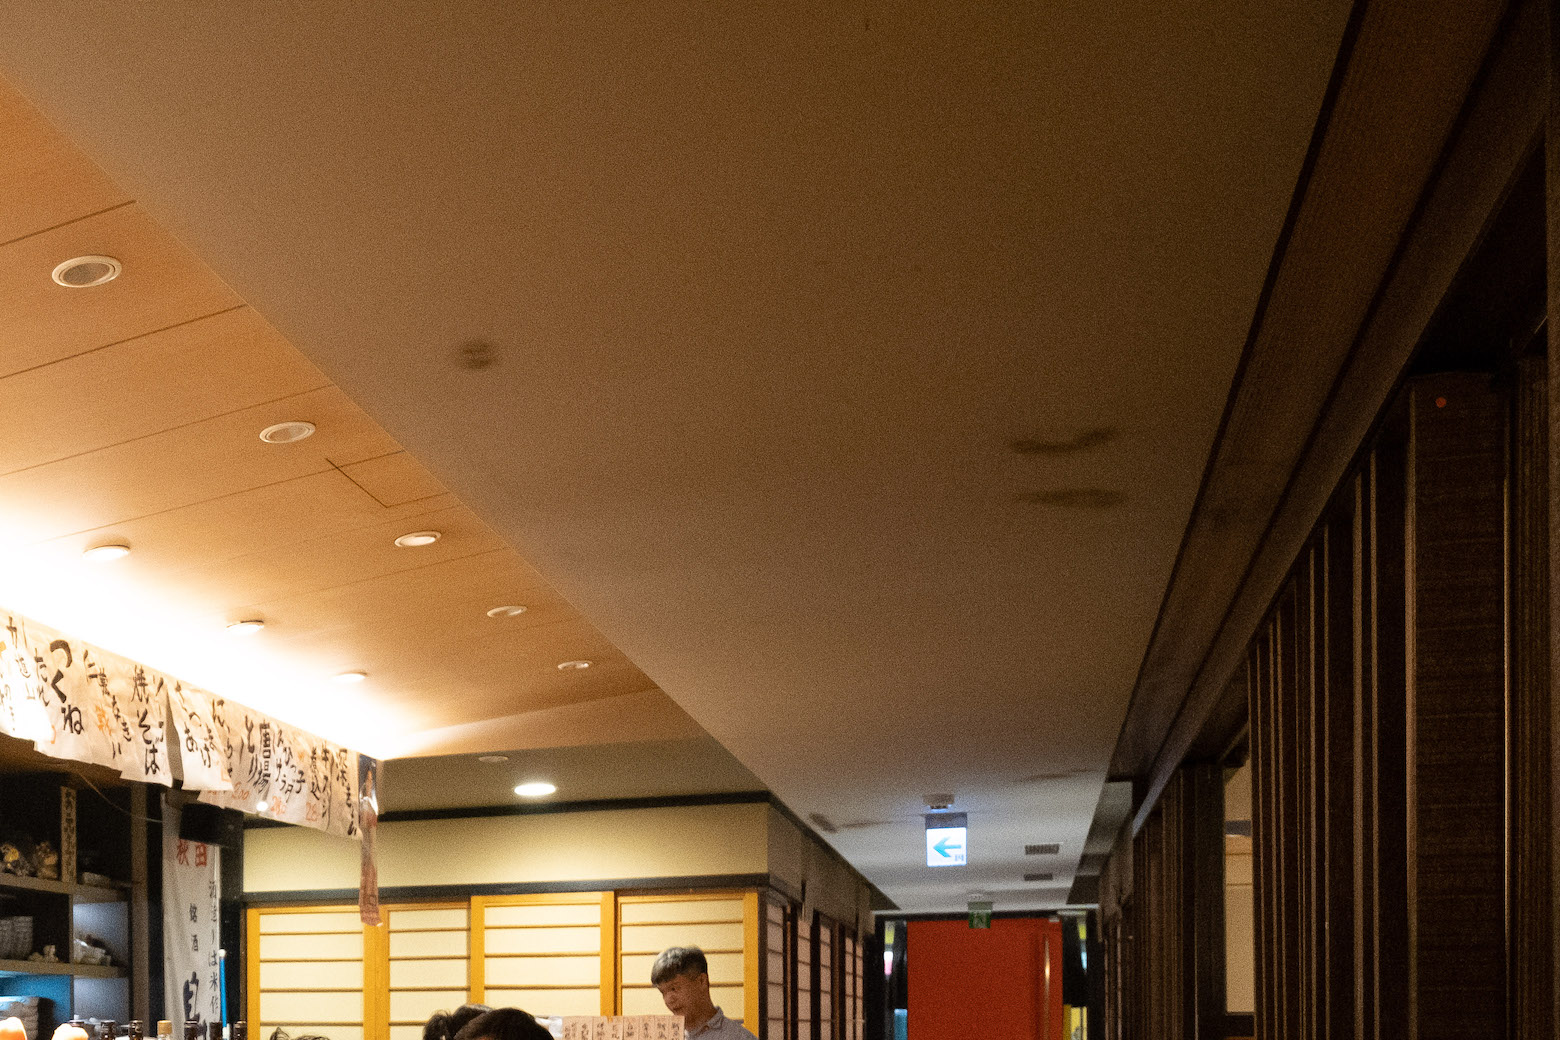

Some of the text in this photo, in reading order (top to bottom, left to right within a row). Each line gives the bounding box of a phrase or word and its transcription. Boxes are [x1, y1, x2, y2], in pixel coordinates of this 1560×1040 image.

[49, 639, 85, 736] つくね
[176, 839, 207, 867] 秋田
